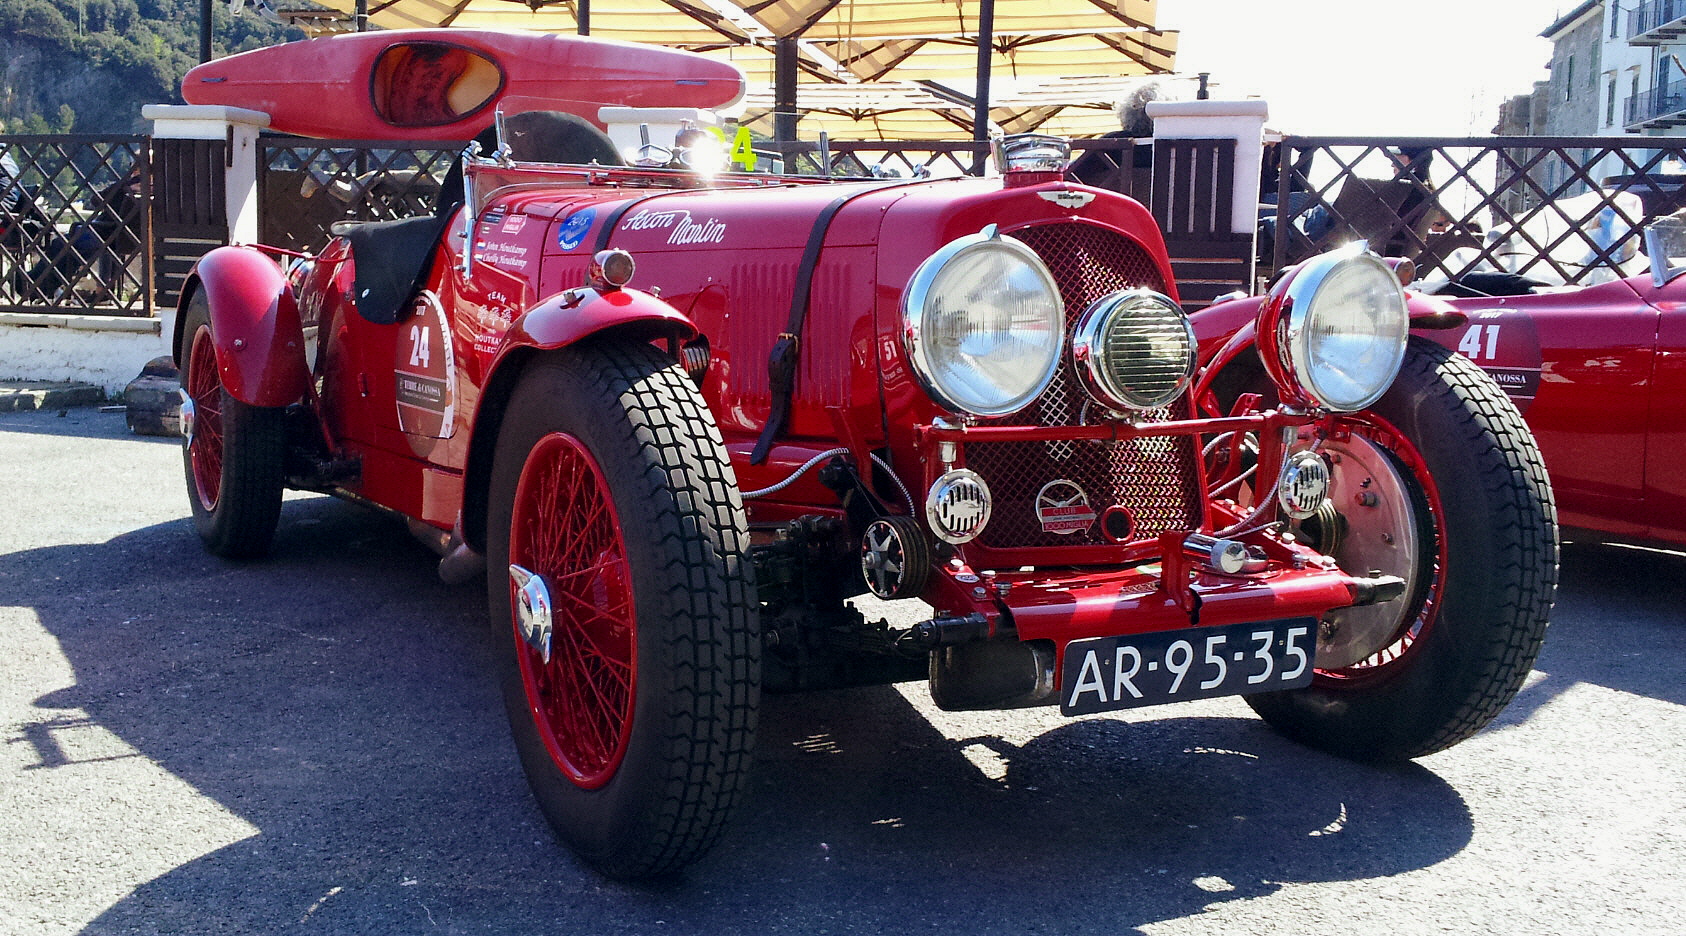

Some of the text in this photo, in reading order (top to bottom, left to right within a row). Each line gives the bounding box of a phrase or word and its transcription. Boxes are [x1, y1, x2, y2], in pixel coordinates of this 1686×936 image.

[621, 209, 726, 245] Aston Martin
[487, 291, 507, 304] TEAM
[409, 325, 430, 368] 24
[1458, 324, 1501, 360] 41
[1489, 373, 1527, 384] ANOSSA
